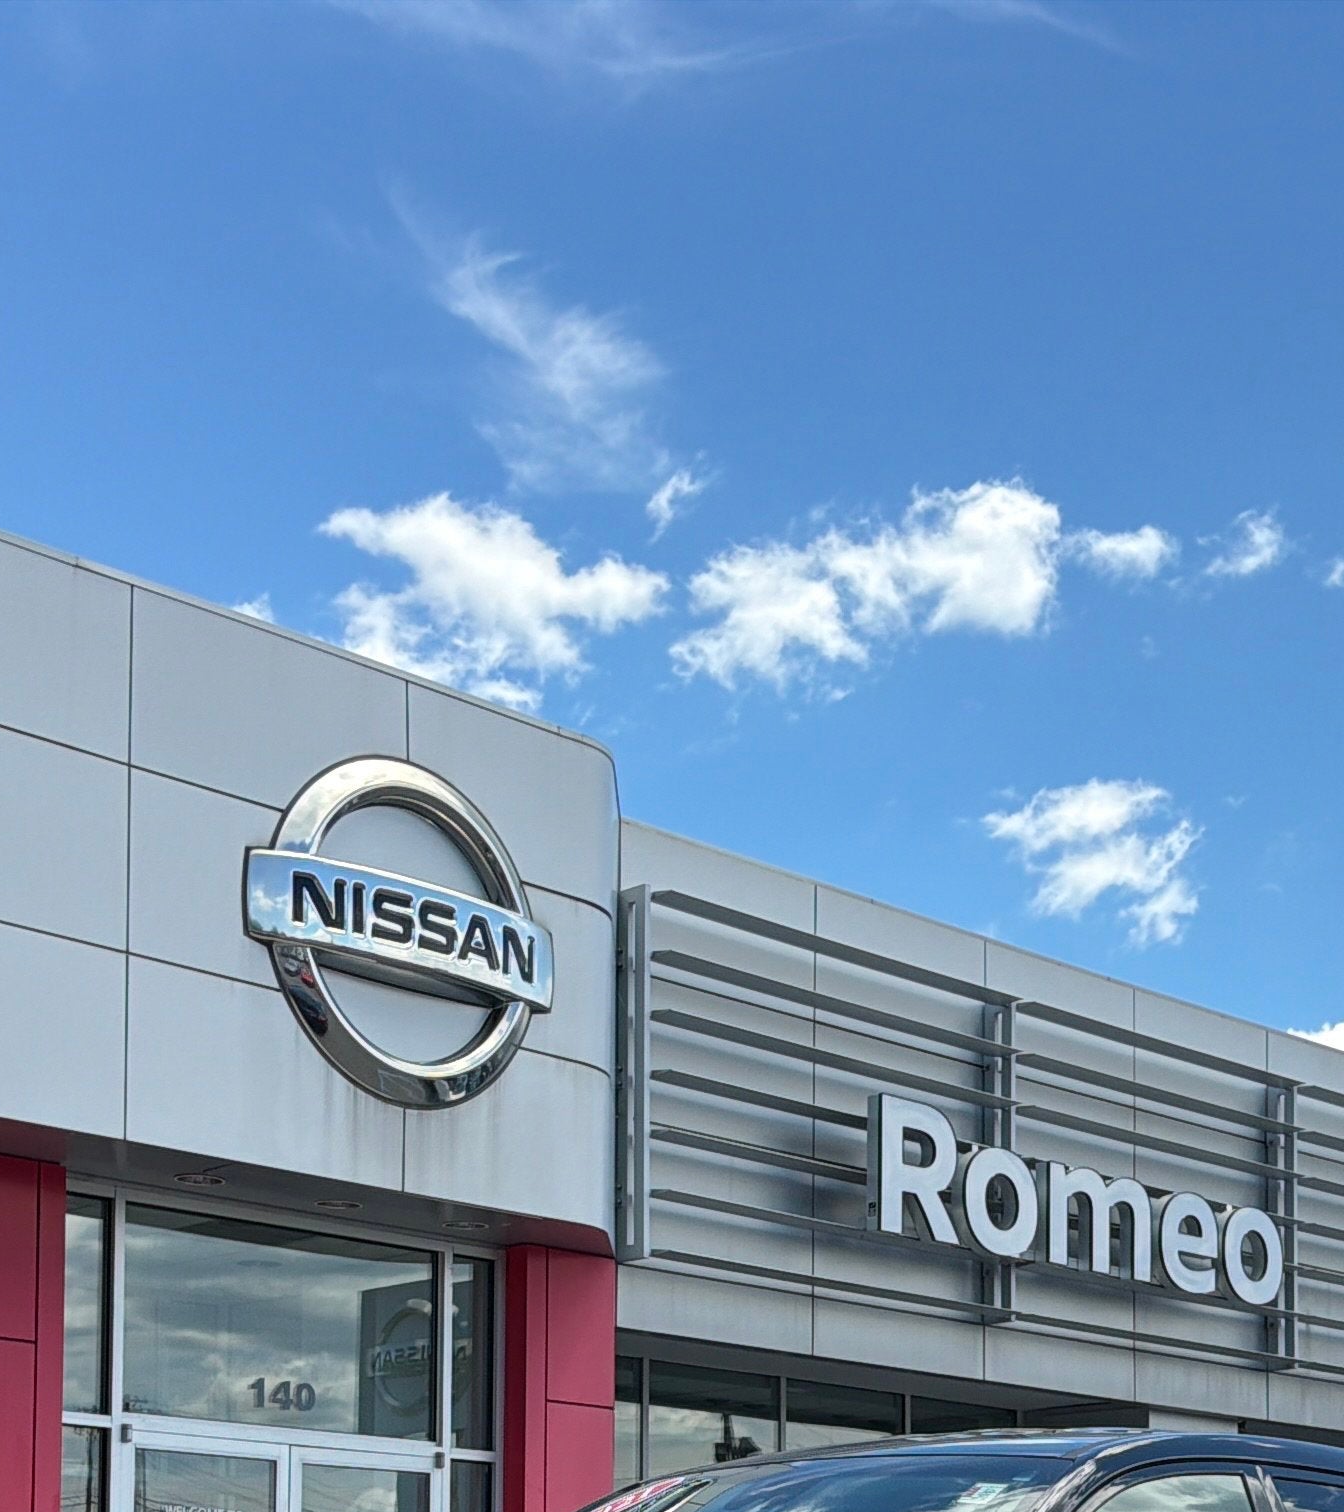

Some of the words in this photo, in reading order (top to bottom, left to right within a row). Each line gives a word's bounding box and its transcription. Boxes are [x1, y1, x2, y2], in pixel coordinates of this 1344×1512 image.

[291, 870, 537, 986] NISSAN
[868, 1092, 1285, 1306] Romeo
[247, 1377, 316, 1412] 140
